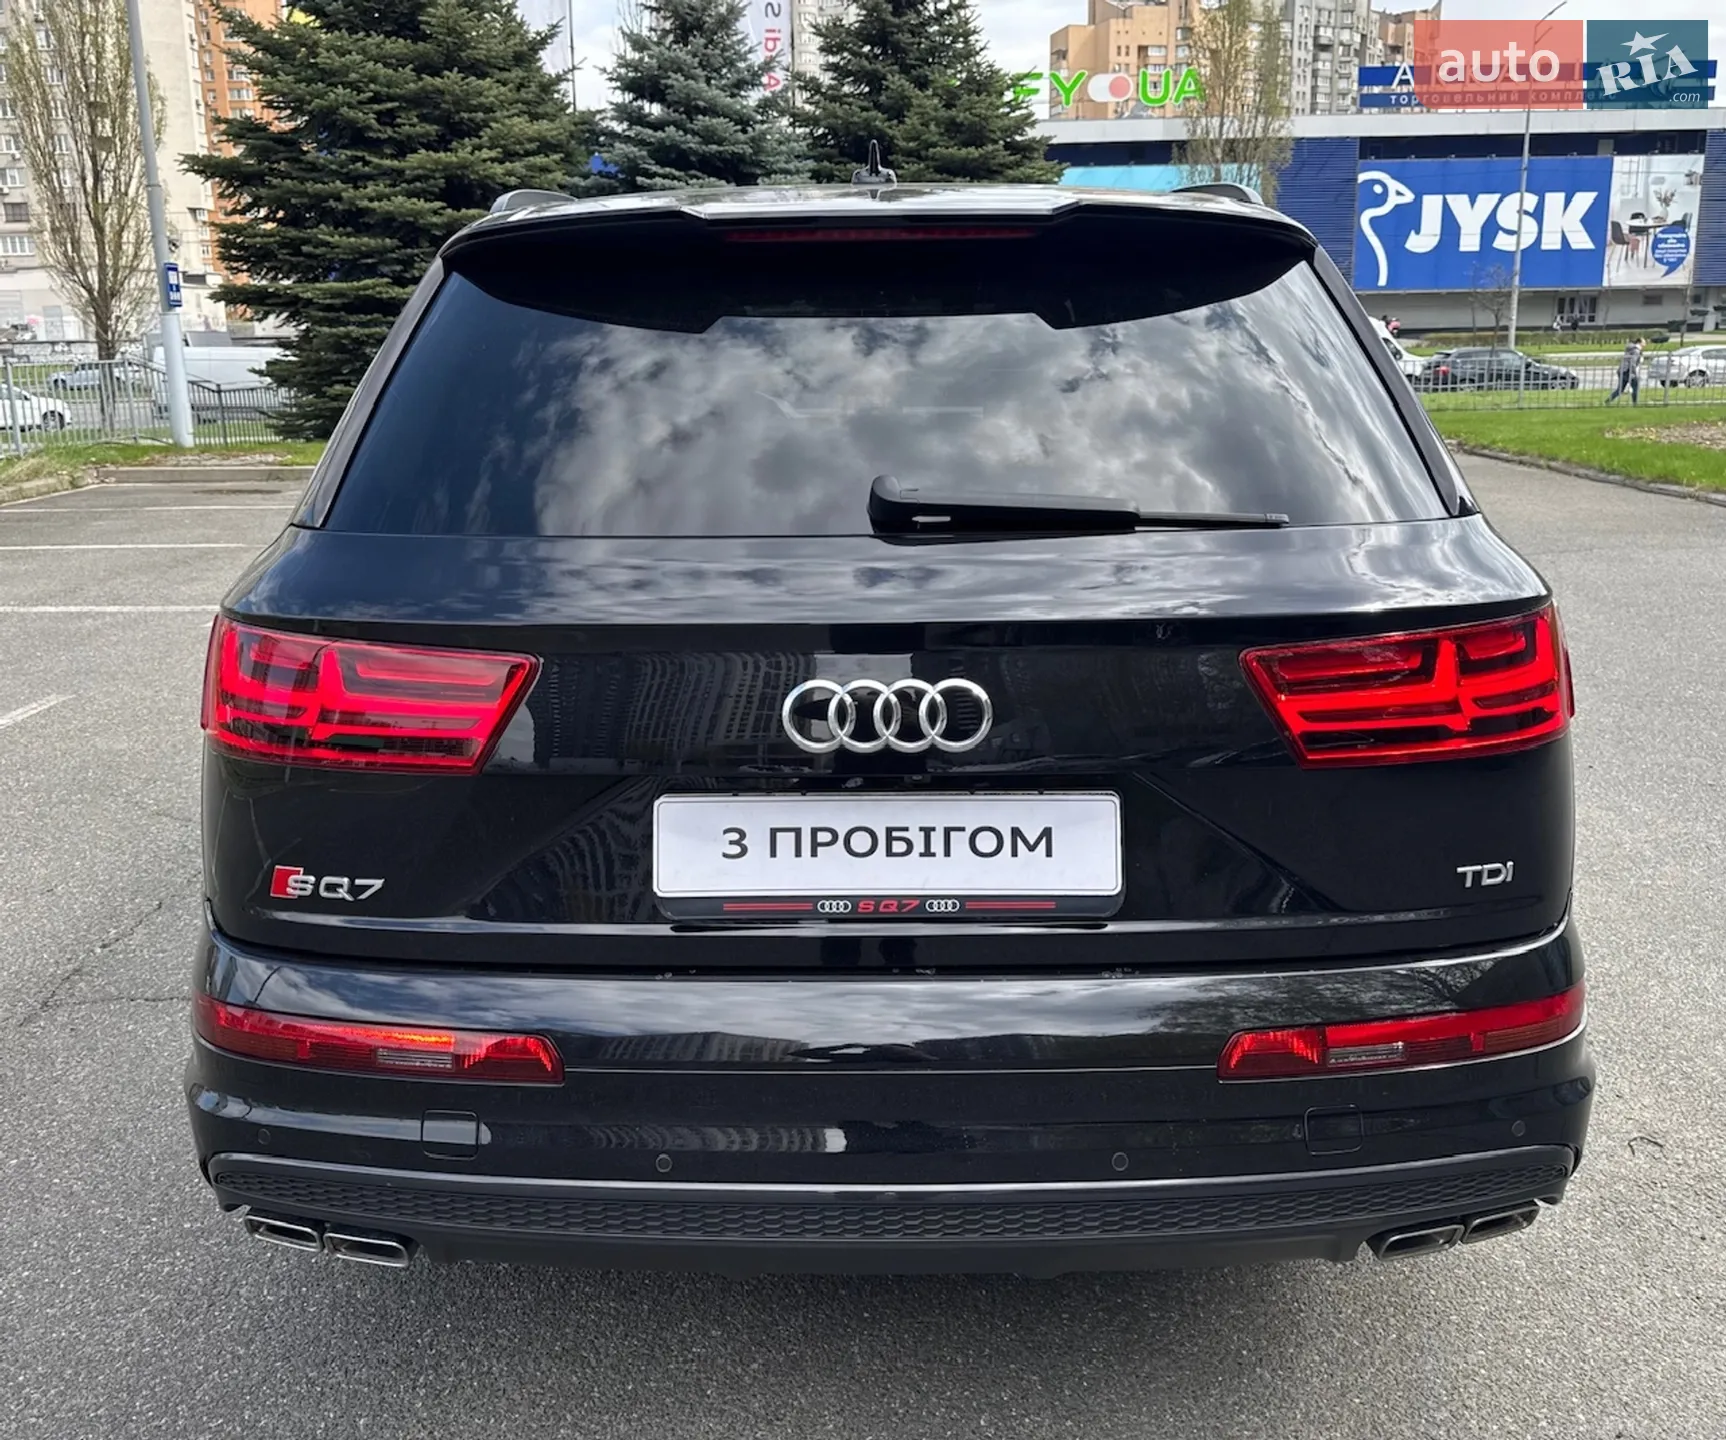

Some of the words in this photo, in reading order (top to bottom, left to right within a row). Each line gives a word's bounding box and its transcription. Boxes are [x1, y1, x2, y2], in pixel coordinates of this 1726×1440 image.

[1404, 191, 1599, 254] JYSK
[769, 826, 1053, 859] ПРОБІГОМ
[286, 874, 385, 902] SQ7
[857, 899, 921, 913] SQ7
